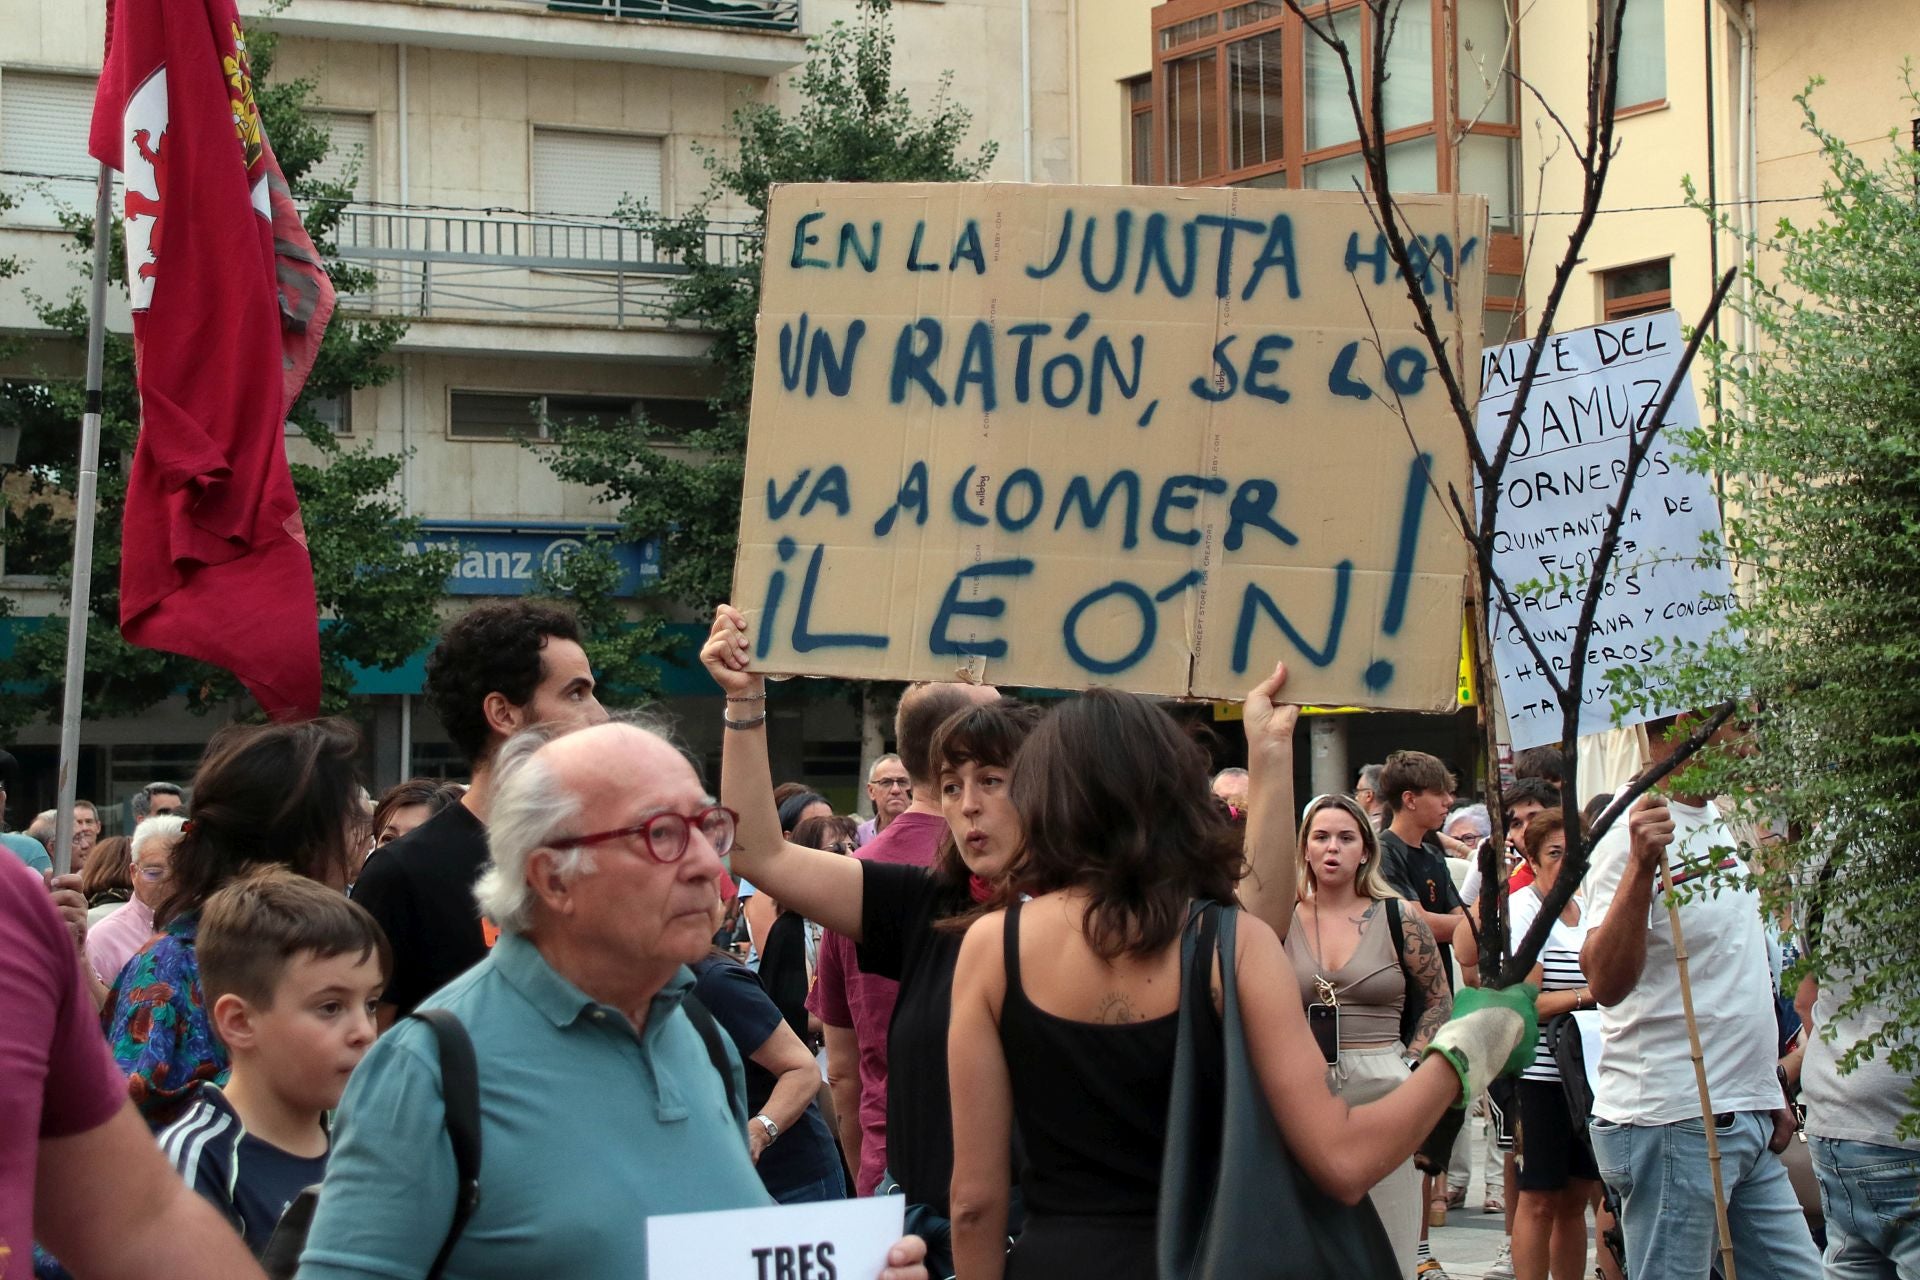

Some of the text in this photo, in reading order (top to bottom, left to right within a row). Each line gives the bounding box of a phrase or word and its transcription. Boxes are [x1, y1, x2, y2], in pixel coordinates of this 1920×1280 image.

[792, 210, 1477, 310] EN LA JUNTA HAY
[781, 313, 1427, 427] UN RATÓN, SE LO
[1594, 322, 1666, 366] DEL
[1497, 380, 1666, 457] JAMUZ
[767, 462, 1298, 550] VA A COMER
[977, 475, 990, 506] milbby
[1475, 451, 1669, 509] ORNEROS
[1493, 496, 1693, 554] QUINTANILA DE
[1645, 608, 1654, 624] Y
[751, 1241, 837, 1280] TRES
